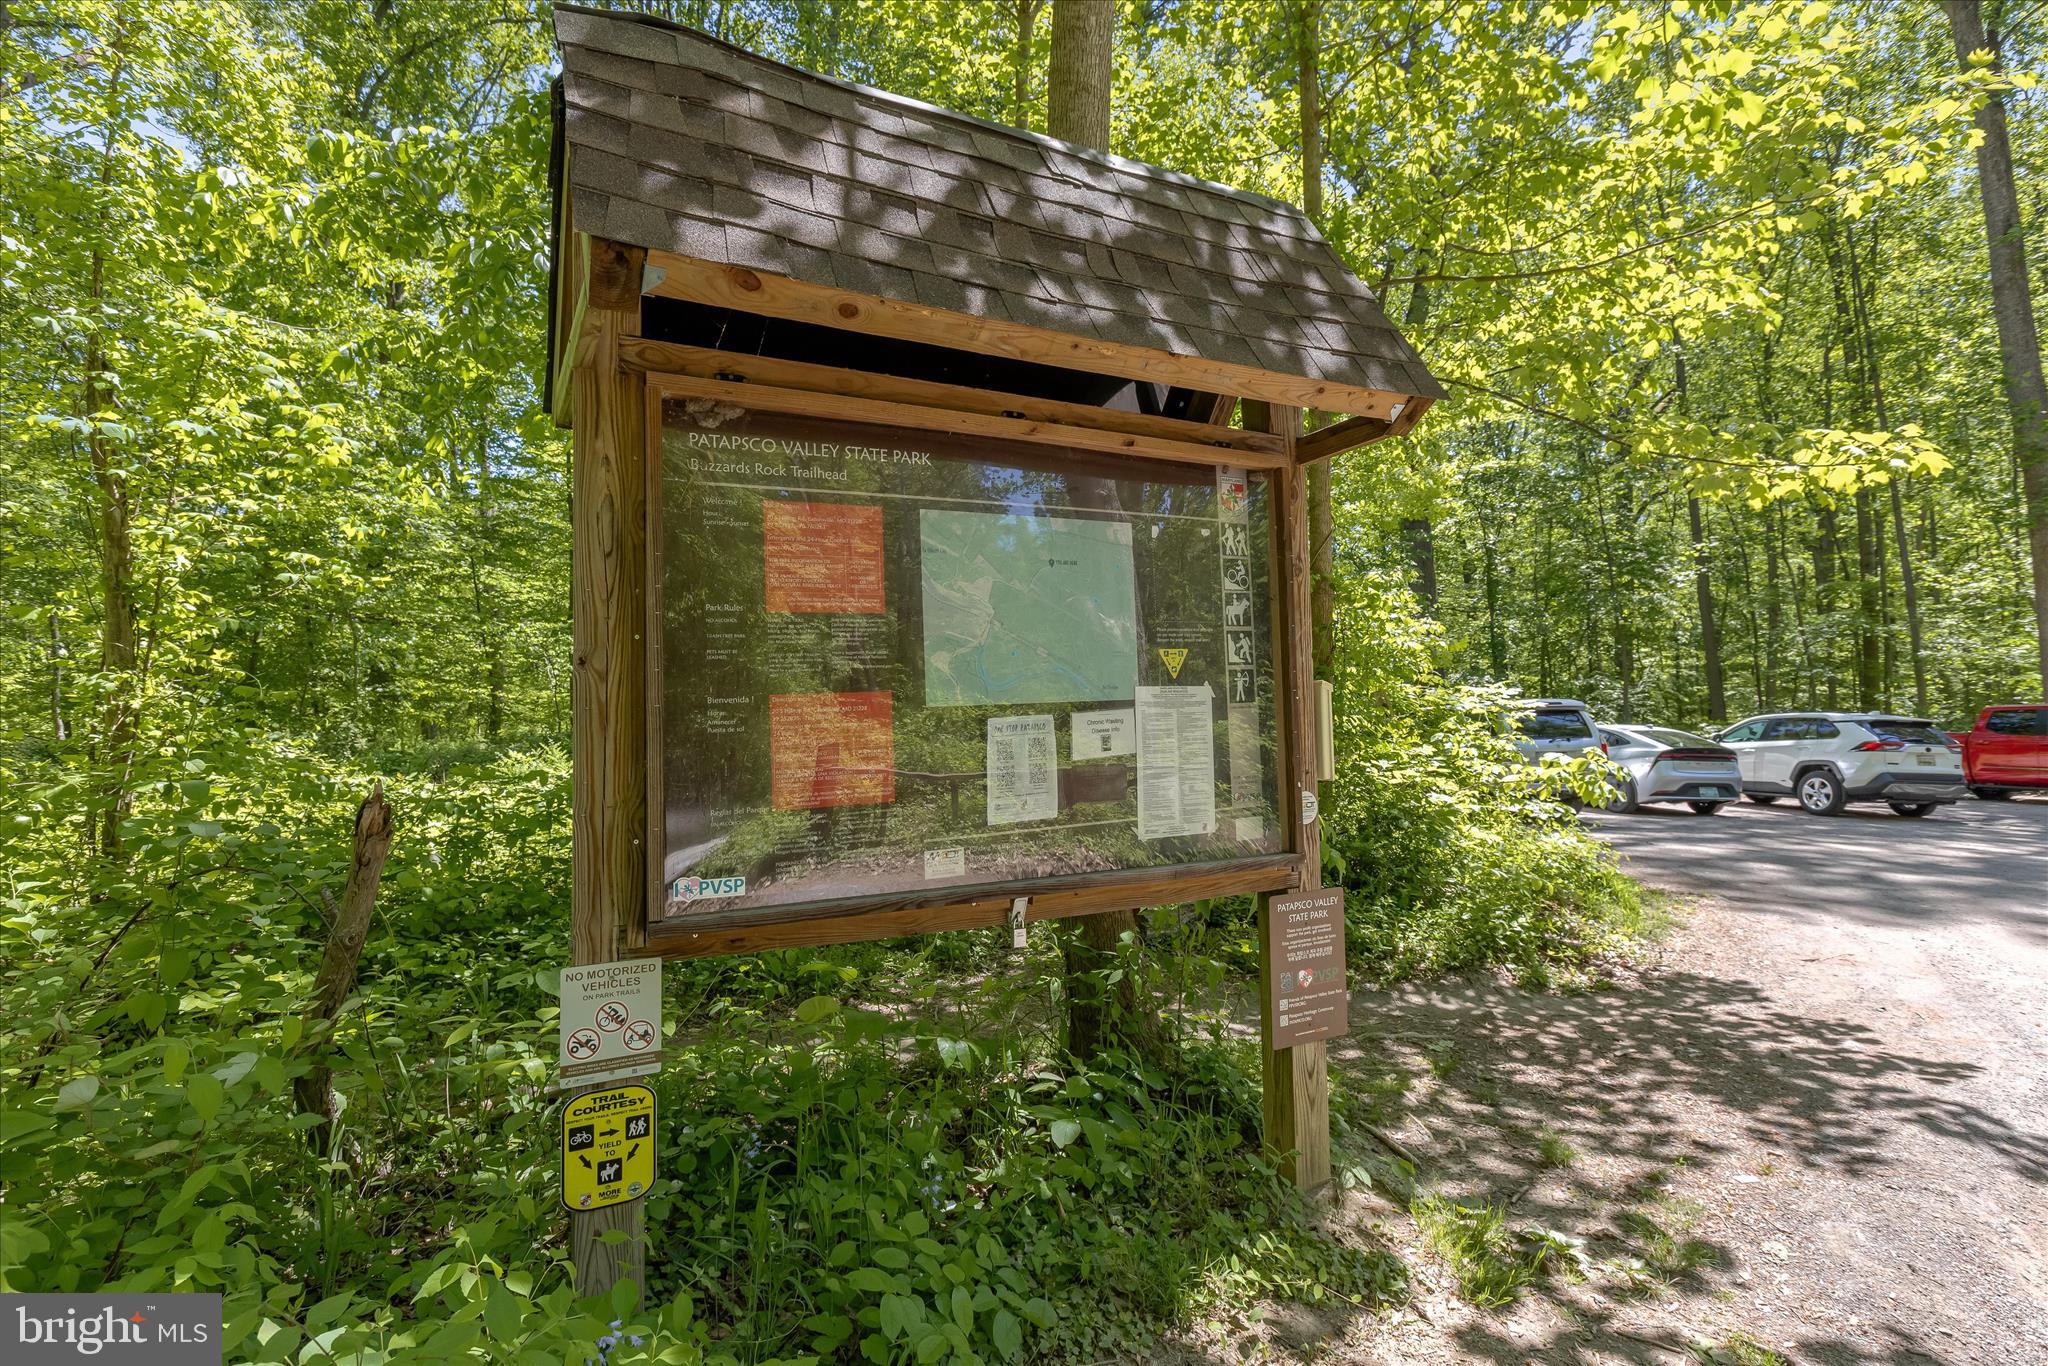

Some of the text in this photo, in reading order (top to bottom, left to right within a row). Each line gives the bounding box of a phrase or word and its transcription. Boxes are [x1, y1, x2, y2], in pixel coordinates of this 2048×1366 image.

[689, 432, 932, 466] PATAPSCO VALLEY STATE PARK
[690, 458, 848, 481] Buzzards Rock Trailhead
[705, 603, 744, 612] Park Rules
[707, 695, 750, 705] Bienvenida
[699, 878, 745, 896] PVSP
[1277, 896, 1339, 913] PATAPSCO VALLEY
[1288, 909, 1329, 923] STATE PARK
[565, 963, 657, 983] NO MOTORIZED
[581, 976, 641, 993] VEHICLES
[582, 989, 641, 1001] ON PARK TRAILS
[590, 1092, 630, 1105] TRAIL
[573, 1096, 646, 1117] COURTESY
[598, 1139, 623, 1150] YIELD
[604, 1149, 616, 1157] TO
[598, 1187, 623, 1199] MORE
